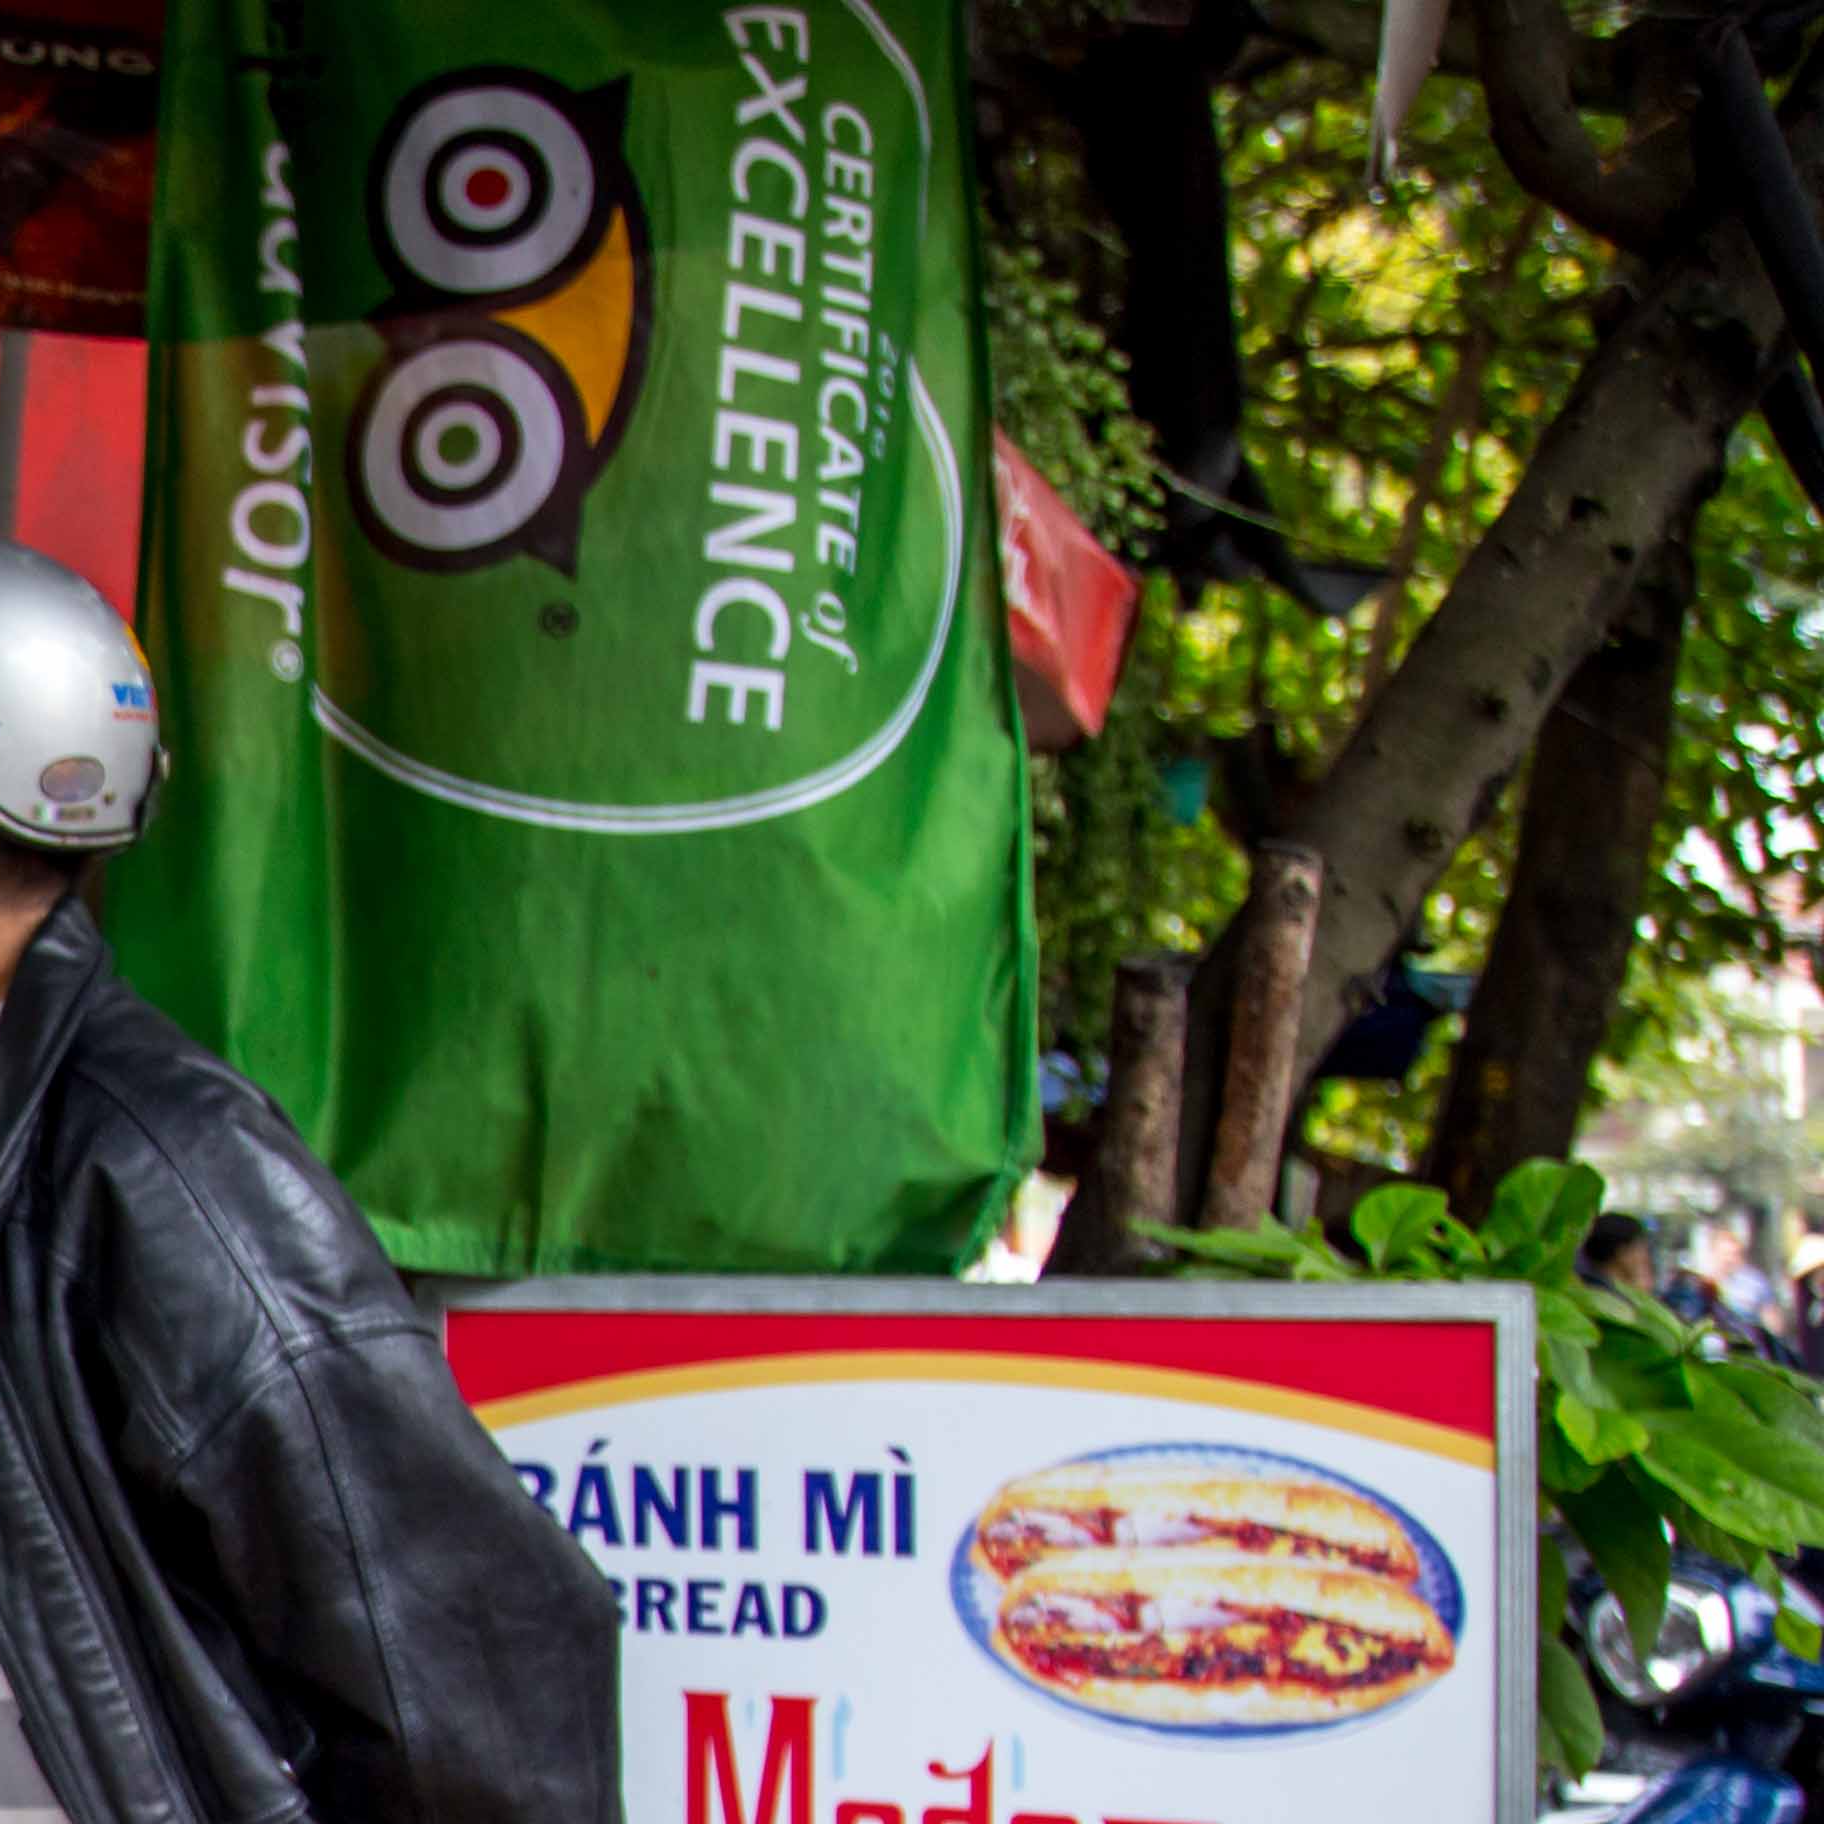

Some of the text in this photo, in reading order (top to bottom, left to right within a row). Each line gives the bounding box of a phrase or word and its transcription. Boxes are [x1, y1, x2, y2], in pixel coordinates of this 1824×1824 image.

[685, 4, 810, 732] EXCELLENCE
[798, 99, 875, 677] CERTIFICATE of
[801, 1443, 916, 1558] MÌ
